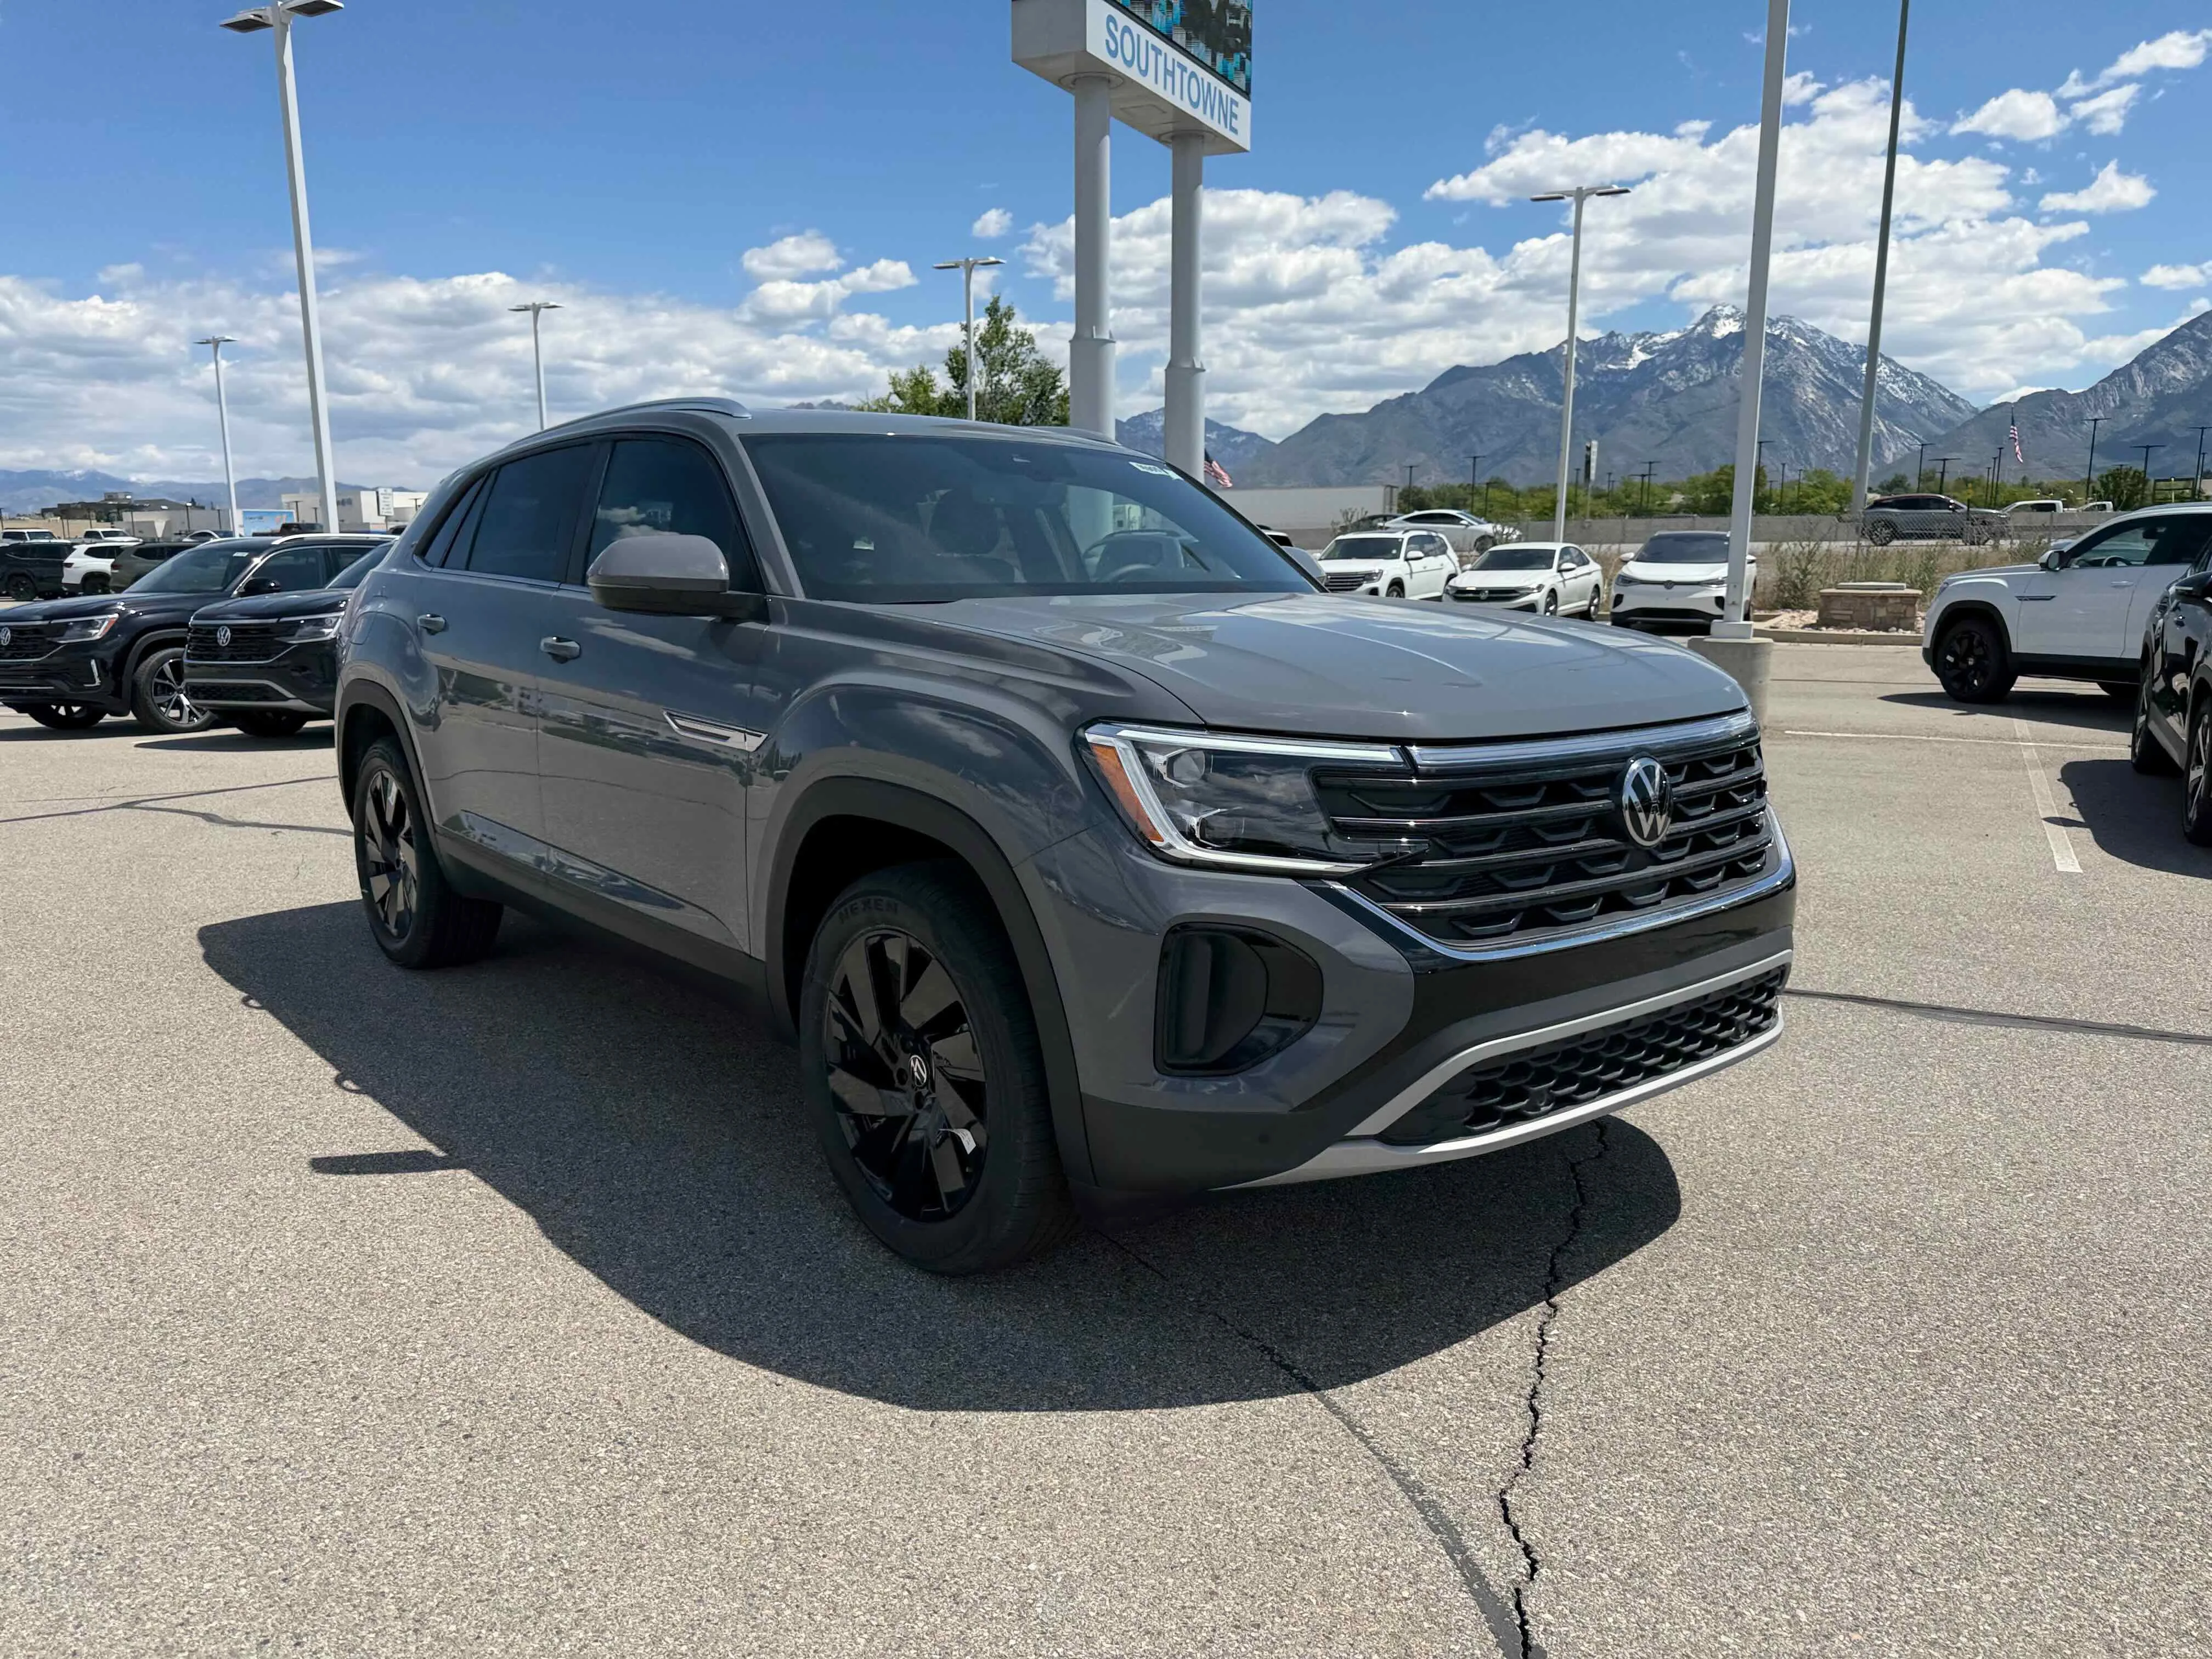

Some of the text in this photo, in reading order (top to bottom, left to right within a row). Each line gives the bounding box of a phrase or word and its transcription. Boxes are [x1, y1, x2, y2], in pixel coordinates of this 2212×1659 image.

[1105, 14, 1239, 136] SOUTHTOWNE
[1622, 757, 1672, 847] VW
[838, 898, 899, 924] NEXEN
